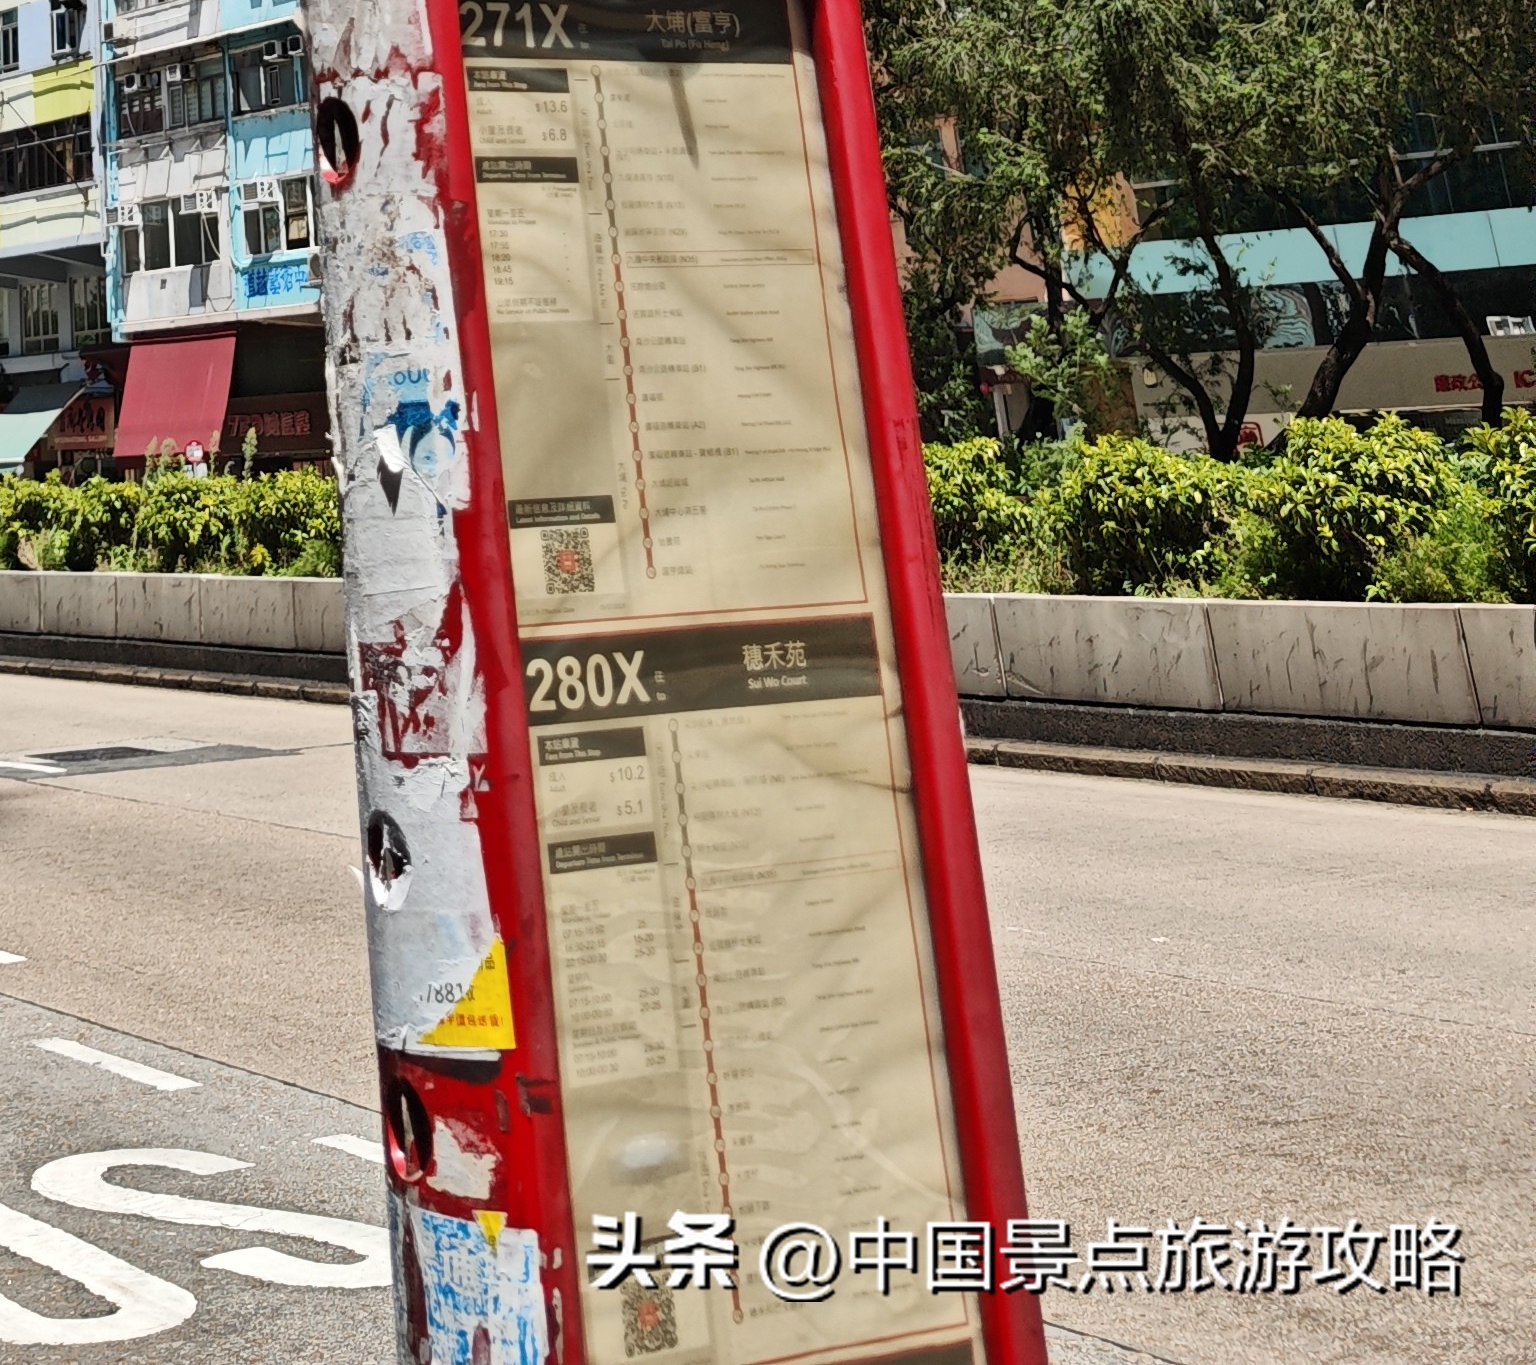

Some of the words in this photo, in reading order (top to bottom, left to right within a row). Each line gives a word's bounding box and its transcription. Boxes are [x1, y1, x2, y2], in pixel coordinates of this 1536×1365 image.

[459, 1, 574, 48] 271X
[742, 640, 807, 671] 穗禾苑
[526, 650, 652, 712] 280X
